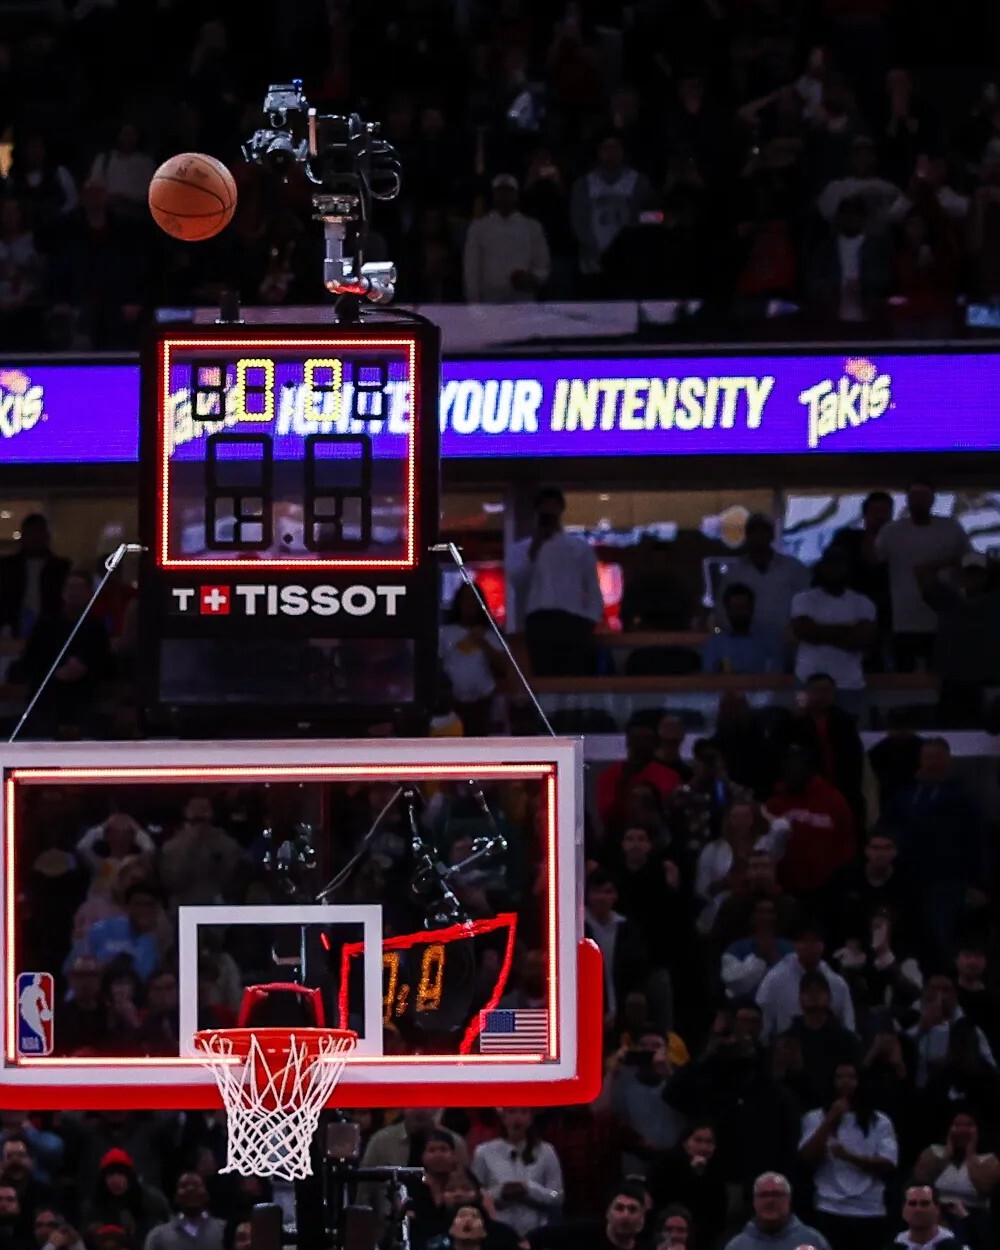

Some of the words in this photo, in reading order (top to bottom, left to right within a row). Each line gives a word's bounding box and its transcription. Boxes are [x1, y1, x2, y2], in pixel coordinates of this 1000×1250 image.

[551, 376, 774, 431] INTENSITY
[798, 374, 892, 448] Takis
[236, 585, 407, 616] TISSOT
